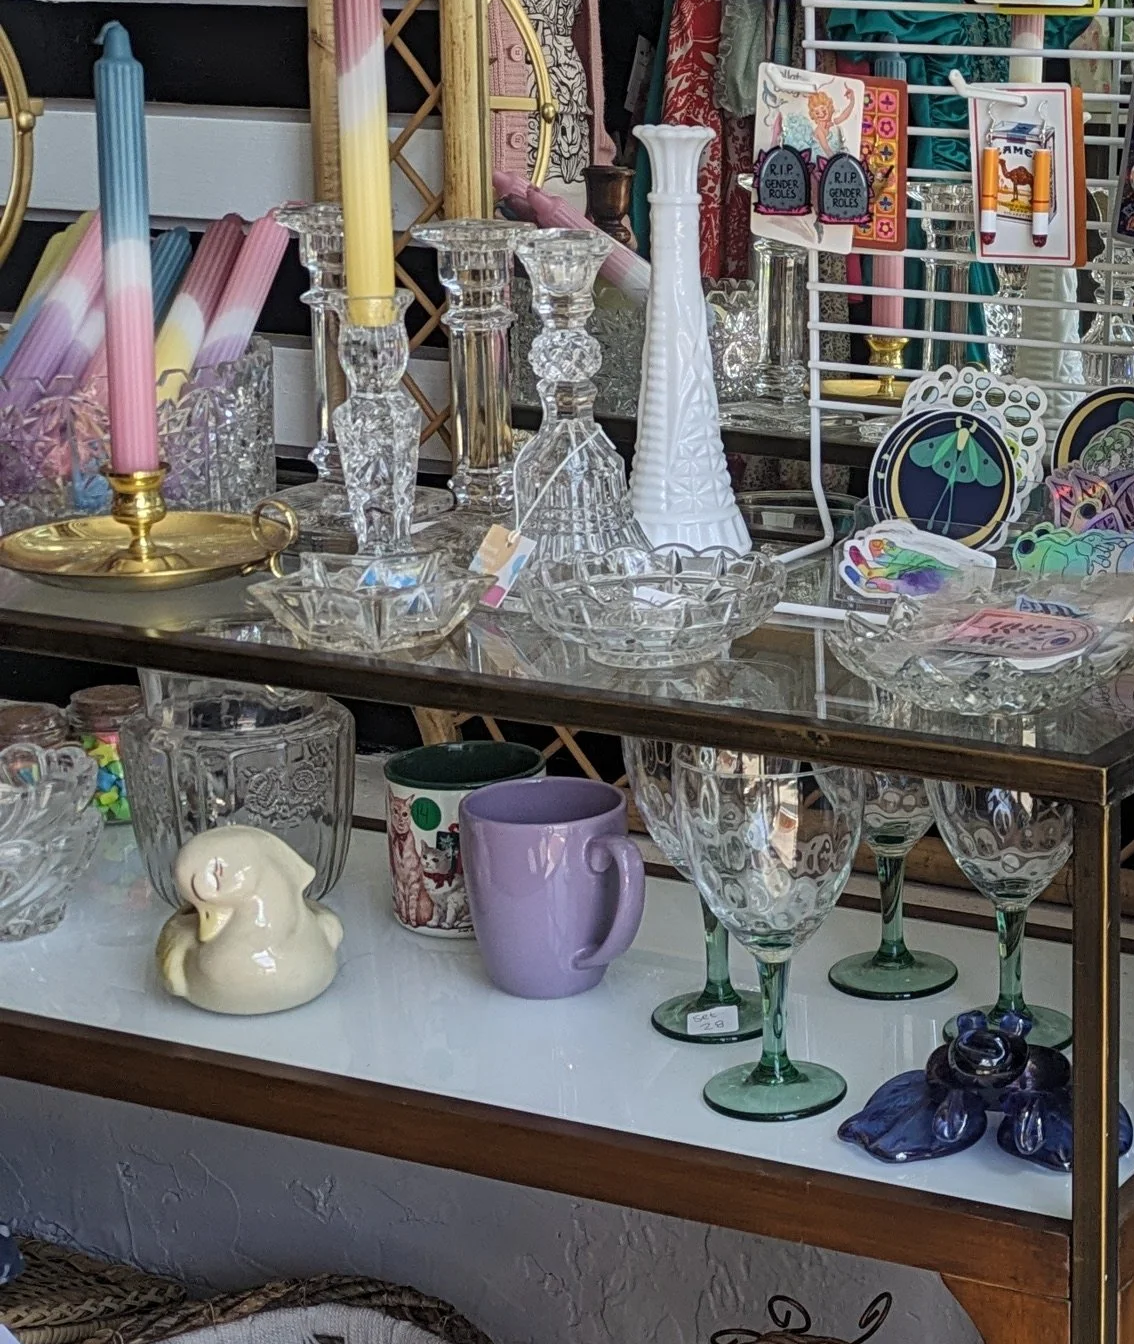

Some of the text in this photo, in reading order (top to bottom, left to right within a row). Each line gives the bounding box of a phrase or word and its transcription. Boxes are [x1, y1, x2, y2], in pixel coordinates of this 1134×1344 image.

[764, 179, 800, 189] GENDER
[768, 188, 797, 199] ROLES
[829, 188, 862, 198] GENDER
[832, 198, 860, 208] ROLES
[416, 806, 430, 824] 14
